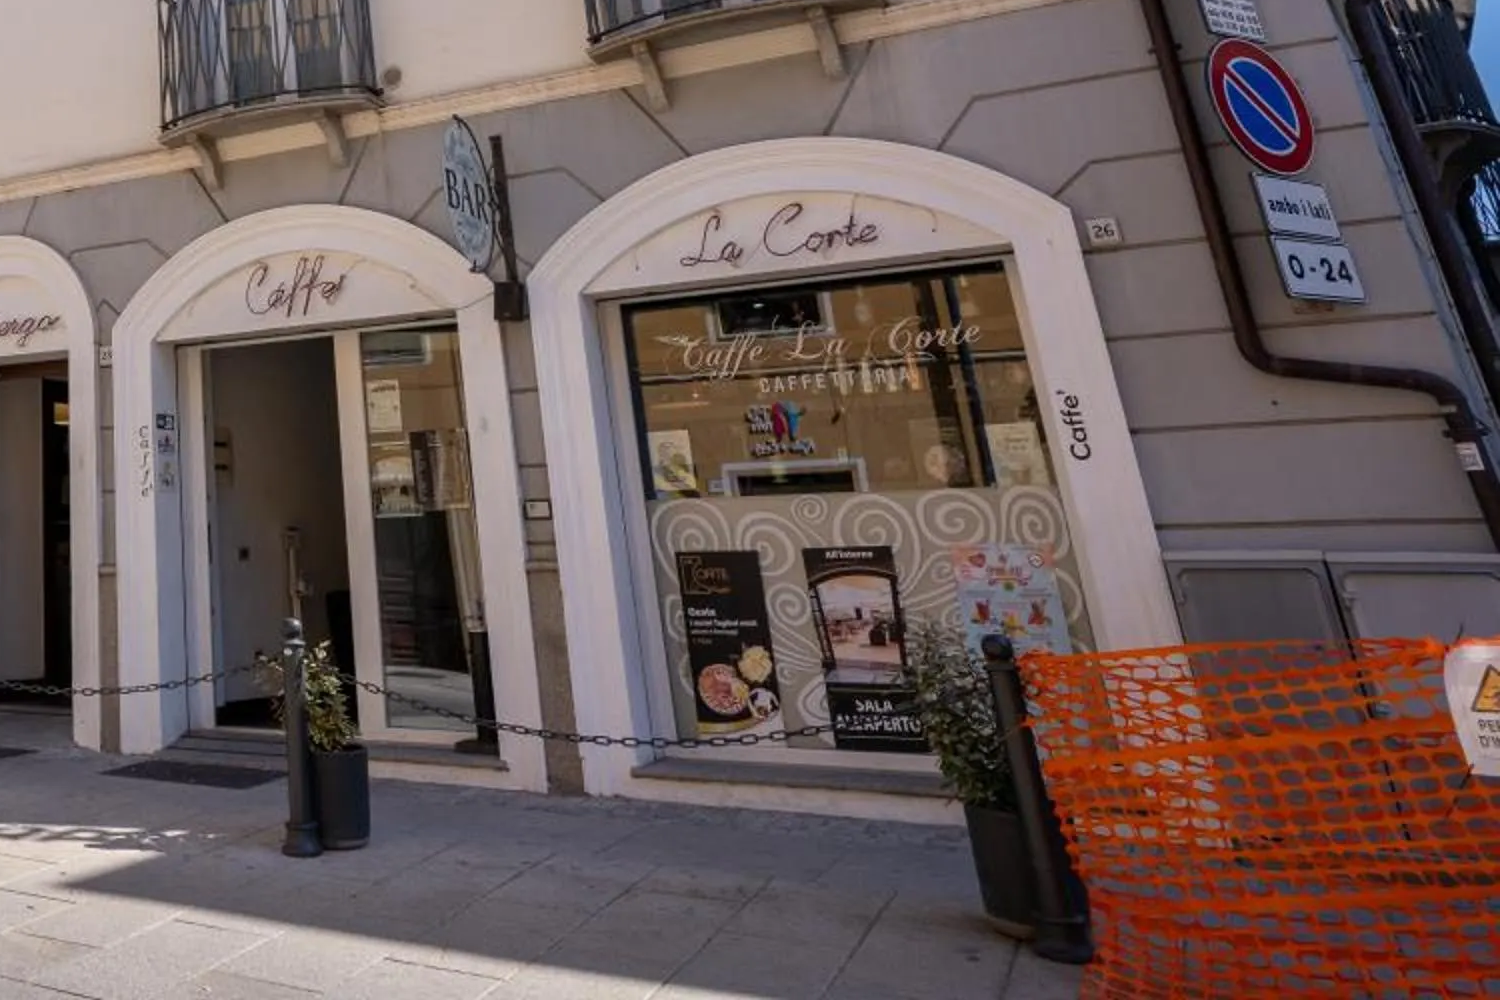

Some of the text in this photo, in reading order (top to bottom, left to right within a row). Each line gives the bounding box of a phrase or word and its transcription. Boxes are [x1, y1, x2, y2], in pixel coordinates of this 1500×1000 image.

[445, 167, 489, 225] BAR
[1267, 195, 1299, 216] ambo
[679, 202, 878, 267] La Corte
[1091, 222, 1115, 240] 26
[888, 315, 982, 360] Corte
[854, 699, 894, 713] SALA
